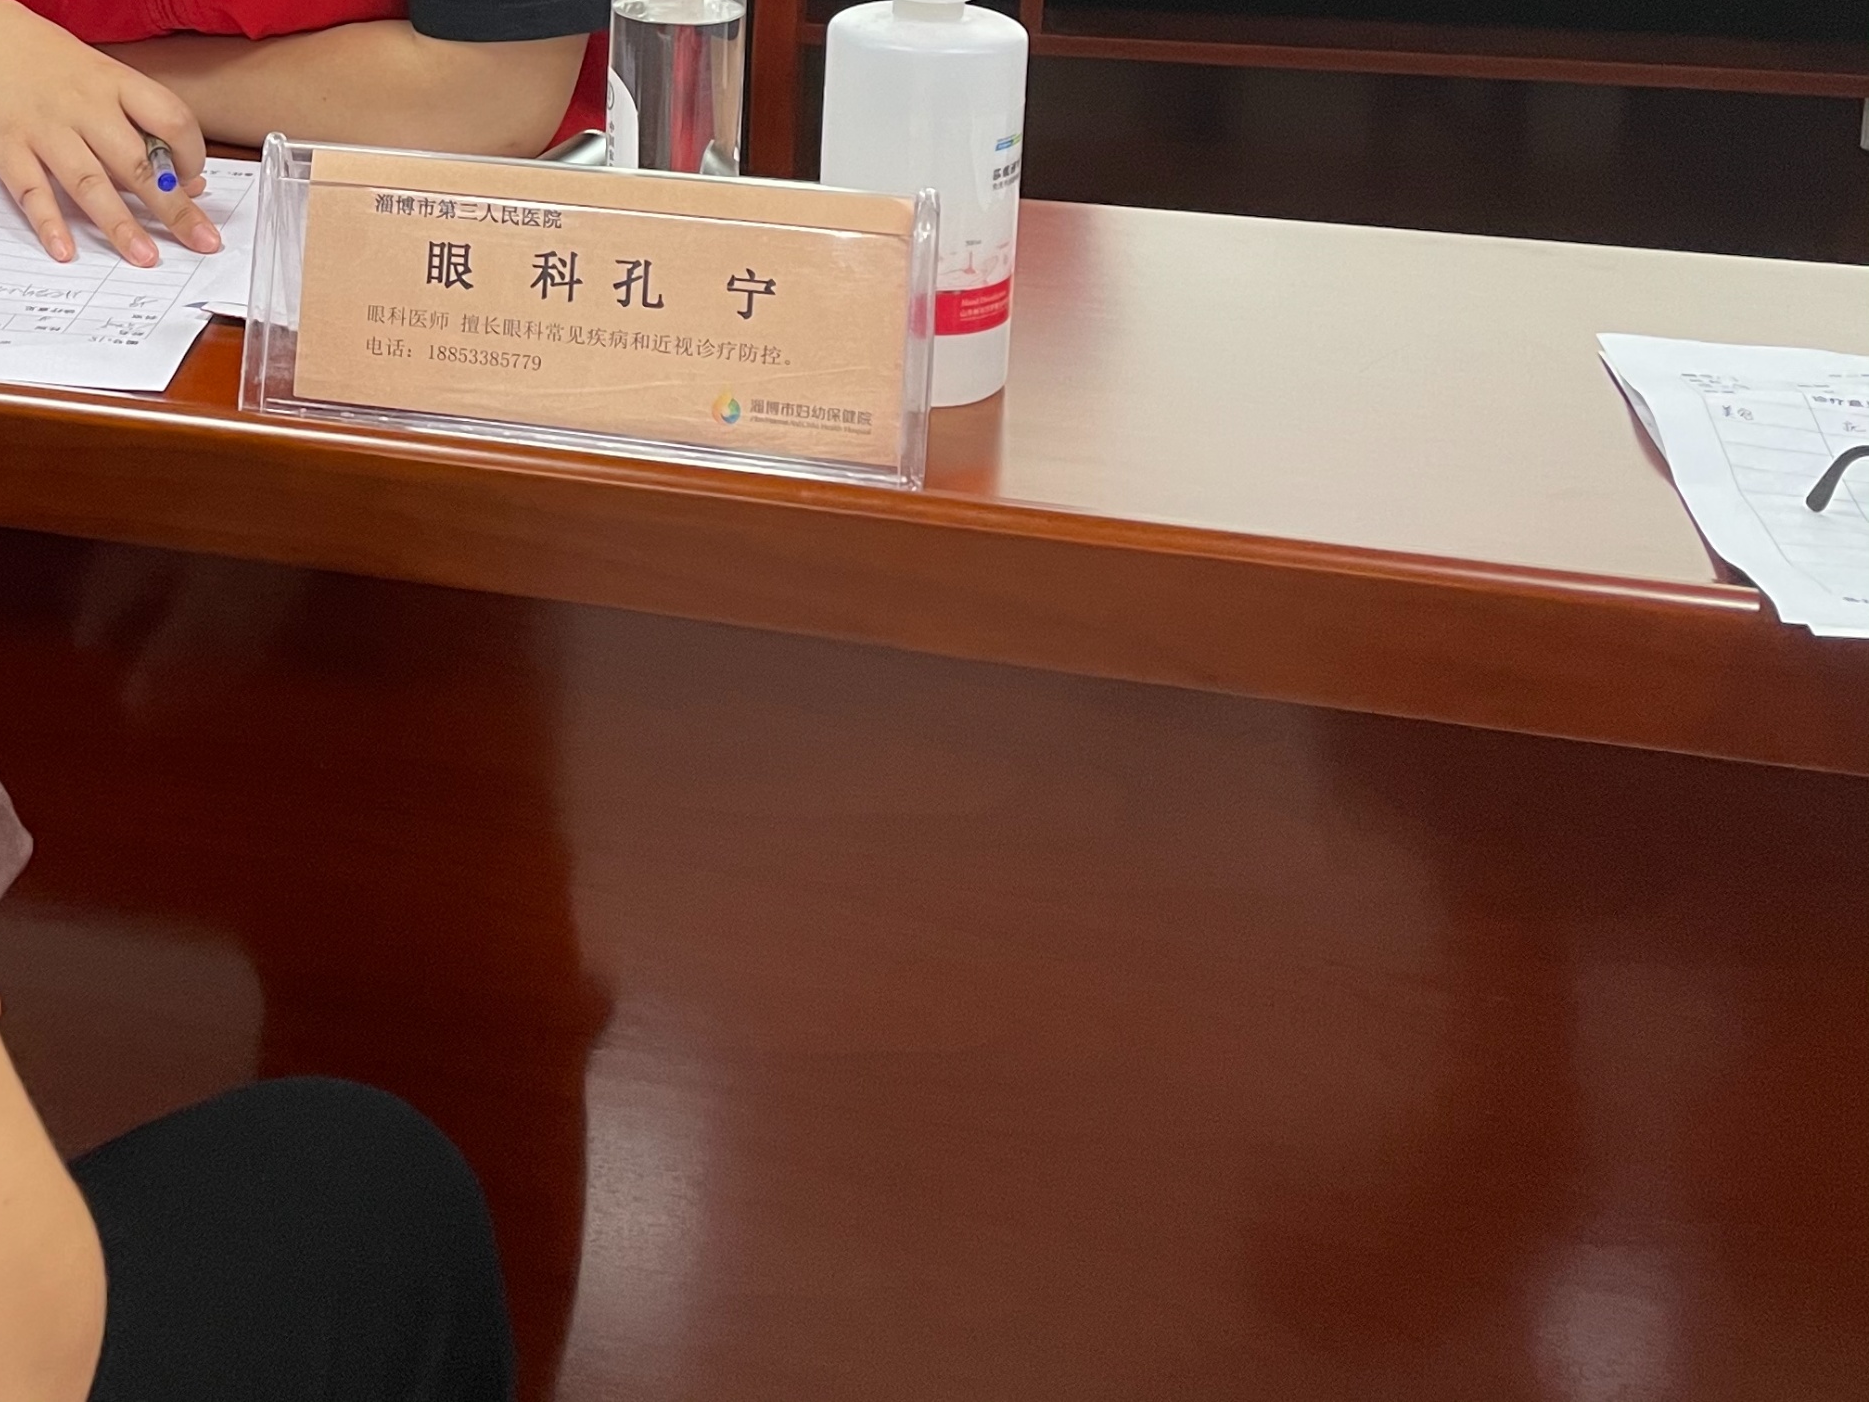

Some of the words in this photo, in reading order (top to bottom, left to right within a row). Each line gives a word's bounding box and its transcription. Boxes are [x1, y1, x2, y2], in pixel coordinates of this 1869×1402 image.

[375, 193, 563, 229] 淄博市第三人民医院
[367, 304, 449, 330] 眼科医师
[750, 398, 873, 426] 淄博市妇幼保健院
